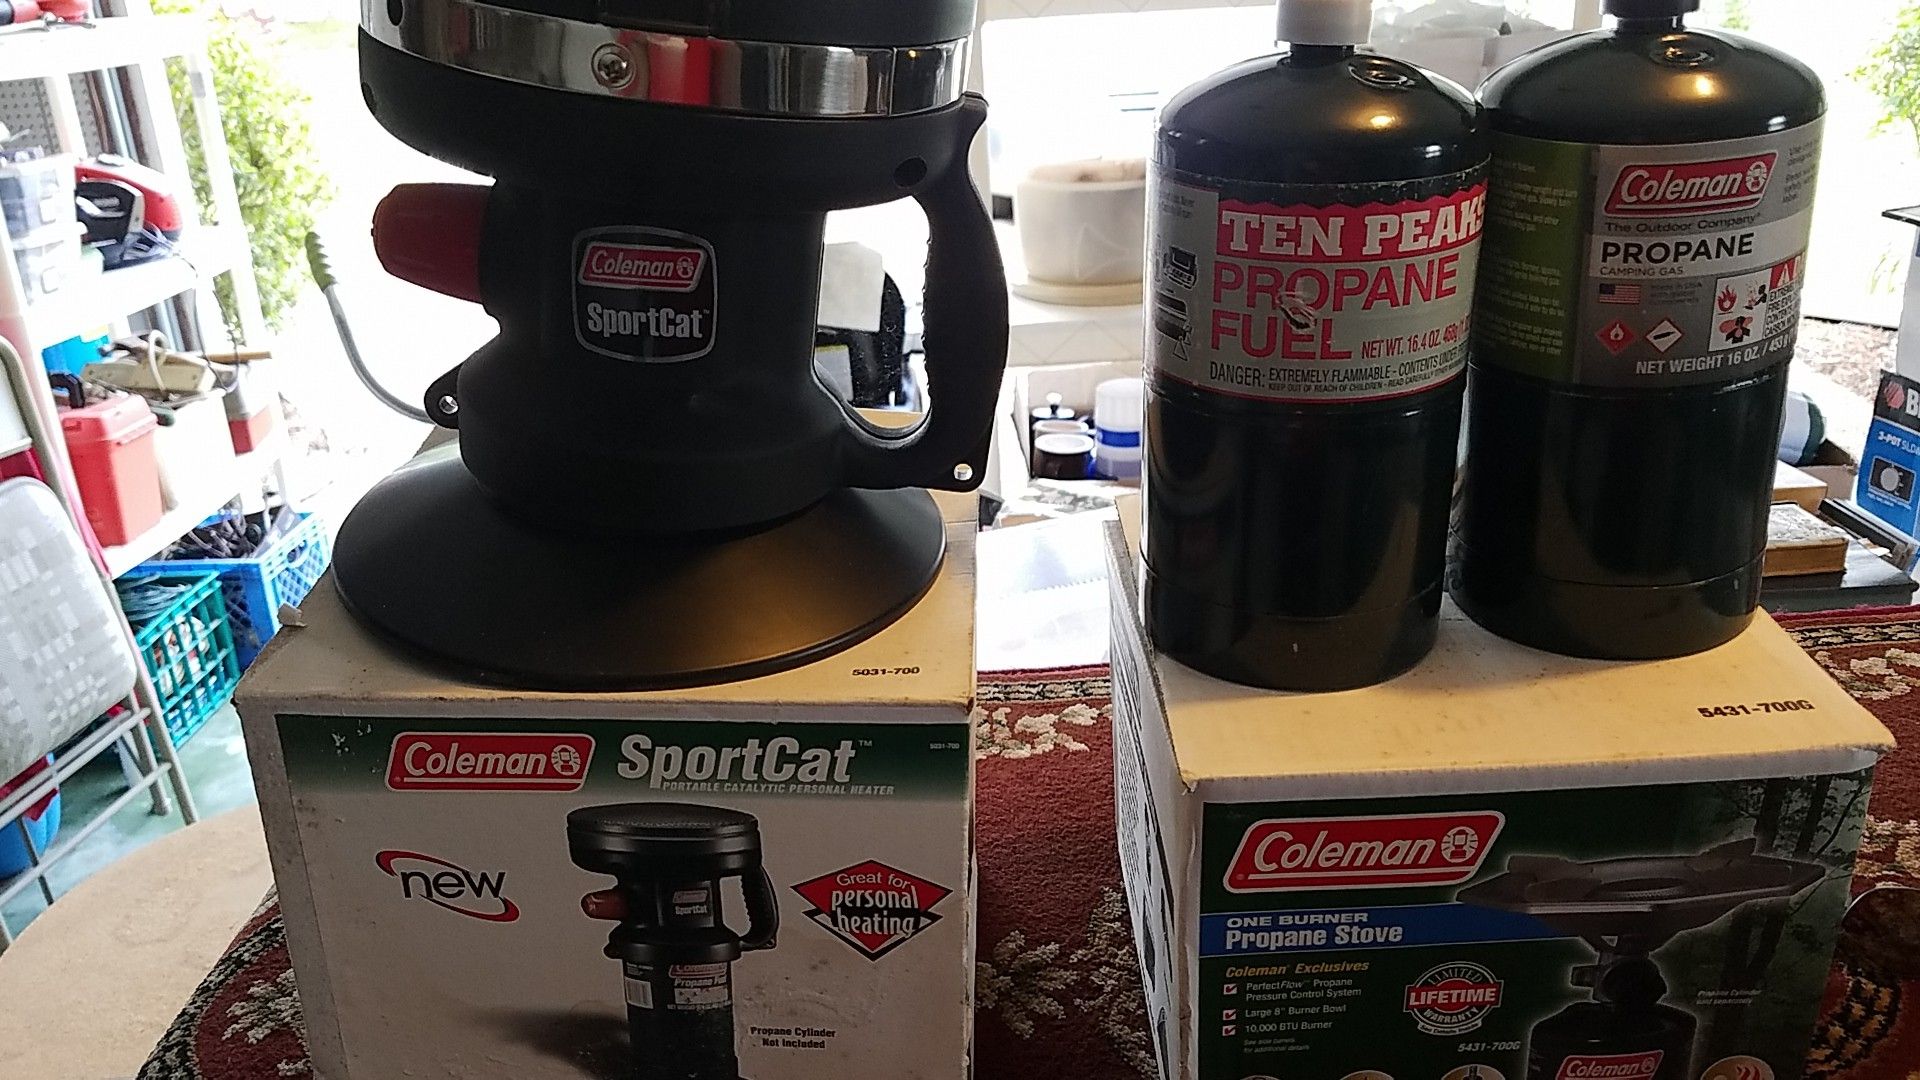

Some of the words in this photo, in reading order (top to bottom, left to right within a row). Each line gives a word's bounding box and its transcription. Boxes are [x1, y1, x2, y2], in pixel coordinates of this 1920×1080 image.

[1620, 168, 1743, 203] Coleman
[1221, 209, 1345, 256] TEN
[1605, 222, 1632, 232] The
[1636, 220, 1691, 233] Outdoor
[1697, 213, 1758, 231] Company
[1601, 232, 1755, 264] PROPANE
[591, 250, 674, 277] Coleman
[1600, 266, 1655, 277] CAMPING
[1658, 265, 1684, 276] GAS
[1212, 253, 1459, 312] PROPANE
[587, 302, 703, 338] SportCat
[1210, 309, 1352, 361] FUEL
[1361, 339, 1384, 359] NET
[1386, 336, 1403, 356] WT.
[1407, 332, 1427, 353] 16.4
[1210, 360, 1266, 388] DANGER:
[1268, 367, 1330, 383] EXTREMELY
[1332, 364, 1392, 383] FLAMMABLE
[1398, 354, 1438, 377] CONTENTS
[1635, 360, 1666, 374] NET
[1669, 354, 1724, 373] WEIGHT
[1727, 351, 1742, 366] 16
[1268, 383, 1287, 392] KEEP
[1287, 384, 1301, 392] OUT
[1339, 383, 1348, 392] OF
[1349, 381, 1383, 392] CHILDREN
[852, 667, 920, 676] 5031-700
[1697, 699, 1816, 718] 5431-700G
[404, 741, 547, 777] Coleman
[617, 734, 857, 789] SportCat
[662, 781, 720, 792] PORTABLE
[723, 783, 785, 794] CATALYTIC
[788, 783, 848, 795] PERSONAL
[849, 784, 895, 796] HEATER
[1254, 830, 1437, 872] Coleman
[400, 870, 506, 899] new
[836, 872, 883, 887] Great
[888, 873, 910, 889] for
[831, 884, 919, 911] personal
[836, 907, 915, 938] heating
[1226, 916, 1272, 928] ONE
[1278, 912, 1368, 925] BURNER
[1226, 927, 1327, 950] Propane
[1334, 923, 1403, 945] Stove
[1226, 964, 1288, 978] Coleman
[1295, 961, 1370, 974] Exclusives
[1427, 968, 1484, 985] LIMITED
[1313, 978, 1353, 989] Propane
[1246, 991, 1288, 1002] Pressure
[1290, 989, 1324, 999] Control
[1326, 988, 1362, 998] System
[1409, 987, 1498, 1006] LIFETIME
[1245, 1008, 1272, 1019] Large
[1288, 1005, 1321, 1015] Burner
[1323, 1004, 1347, 1013] Bowl
[1423, 1007, 1480, 1024] WARRANTY
[750, 1026, 792, 1037] Propane
[794, 1027, 836, 1038] Cylinder
[1279, 1022, 1299, 1031] BTU
[1301, 1021, 1333, 1031] Burner
[762, 1037, 781, 1047] Not
[782, 1038, 826, 1049] Included
[1566, 1060, 1641, 1077] Coleman
